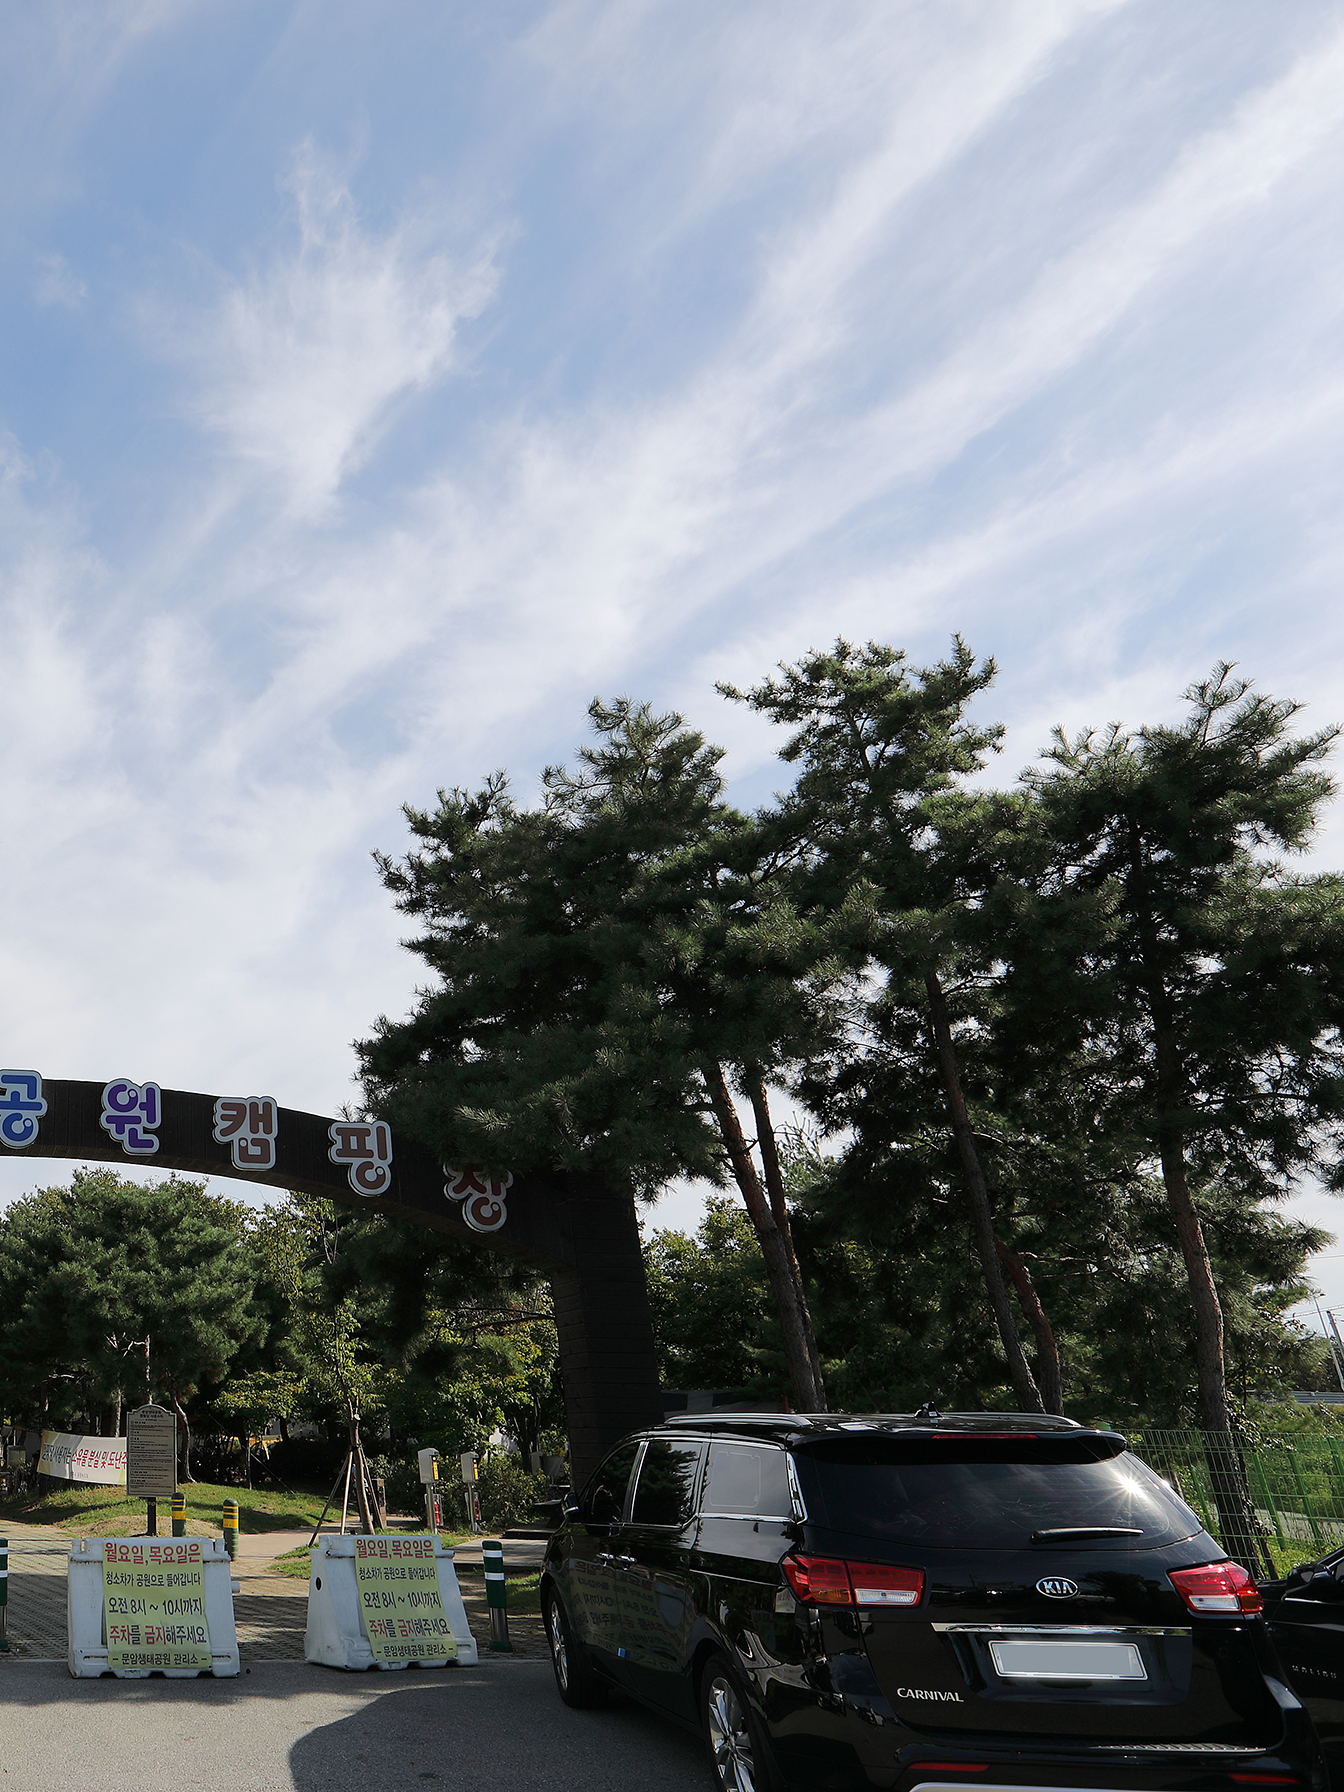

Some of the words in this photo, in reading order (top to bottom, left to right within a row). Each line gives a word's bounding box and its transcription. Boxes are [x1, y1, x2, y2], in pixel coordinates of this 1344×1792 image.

[106, 1571, 134, 1586] 청소차가
[136, 1574, 164, 1587] 공원으로
[166, 1572, 201, 1586] 들어갑니다
[359, 1567, 383, 1580] 청소차가
[383, 1567, 407, 1580] 공원으로
[408, 1567, 435, 1580] 들어갑니다
[108, 1597, 128, 1614] 오전
[131, 1599, 147, 1615] 8시
[162, 1597, 203, 1615] 10시까지
[363, 1592, 381, 1609] 오전
[382, 1592, 396, 1609] 8시
[407, 1591, 442, 1608] 10시까지
[110, 1625, 141, 1645] 주차를
[144, 1625, 207, 1645] 금지해주세요
[369, 1619, 397, 1638] 주차를
[398, 1618, 450, 1637] 금지해주세요
[383, 1646, 425, 1657] 문암생태공원
[426, 1644, 447, 1656] 관리소
[121, 1653, 172, 1665] 문암생태공원
[173, 1653, 199, 1664] 관리소
[896, 1687, 965, 1703] CARNIVAL
